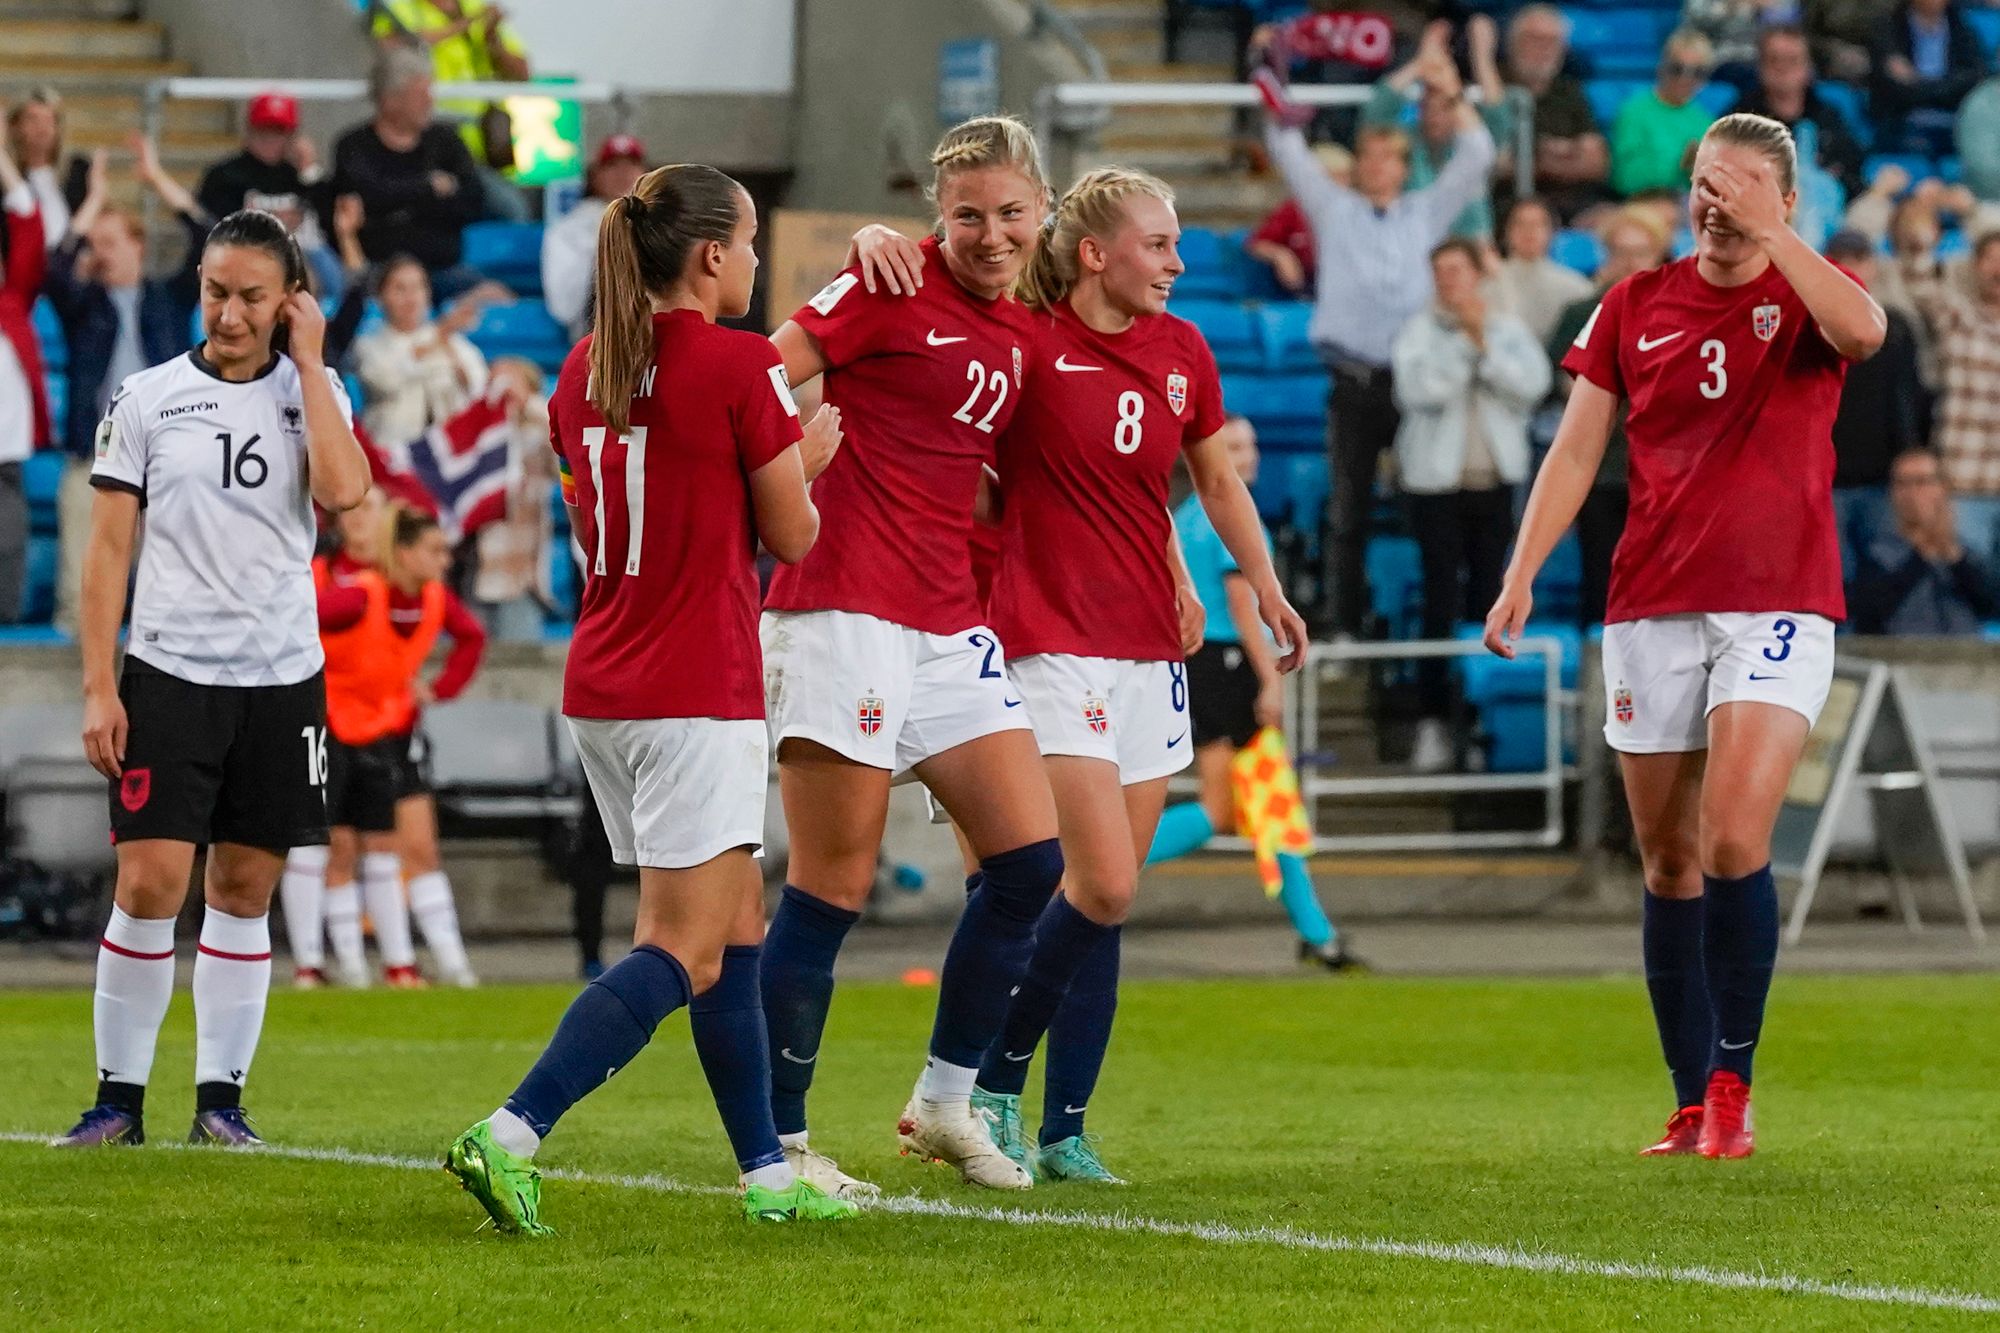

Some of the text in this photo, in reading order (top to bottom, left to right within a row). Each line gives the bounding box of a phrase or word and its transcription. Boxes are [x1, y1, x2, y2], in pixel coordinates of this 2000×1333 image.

[952, 360, 1008, 433] 22
[1699, 339, 1727, 399] 3
[160, 401, 218, 420] macron
[1114, 390, 1144, 454] 8
[215, 433, 268, 489] 16
[582, 426, 648, 577] 11
[1763, 618, 1796, 661] 3
[1168, 661, 1185, 712] 8
[301, 726, 328, 786] 16
